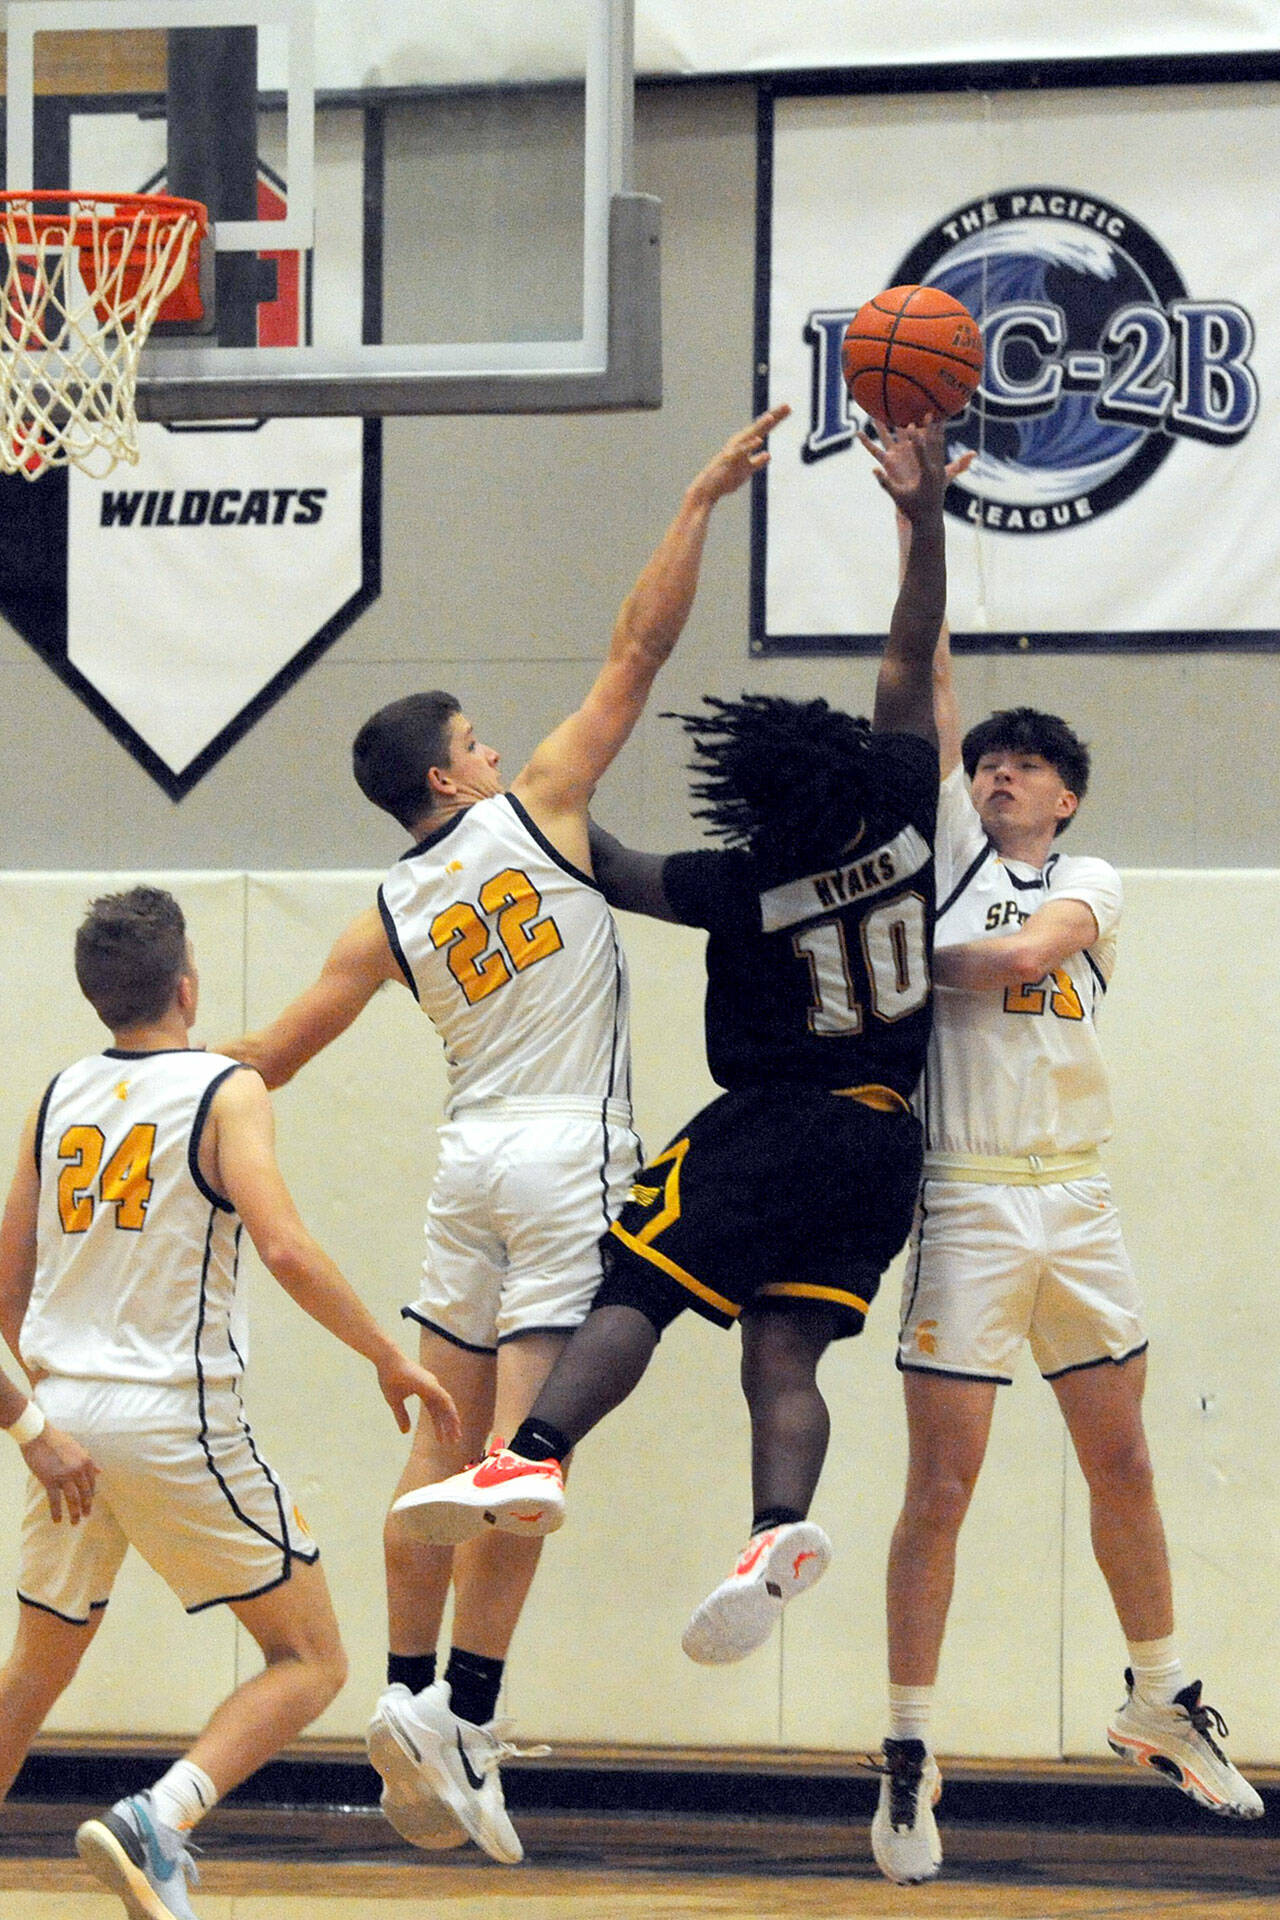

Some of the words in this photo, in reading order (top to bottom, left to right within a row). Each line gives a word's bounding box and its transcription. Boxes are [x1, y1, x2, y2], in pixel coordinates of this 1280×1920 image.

[941, 201, 999, 241] THE
[1010, 194, 1126, 238] PACIFIC
[100, 488, 328, 528] WILDCATS
[967, 497, 1093, 529] LEAGUE
[811, 851, 896, 908] HYAKS
[428, 867, 565, 1007] 22
[792, 890, 932, 1037] 10
[57, 1122, 158, 1235] 24
